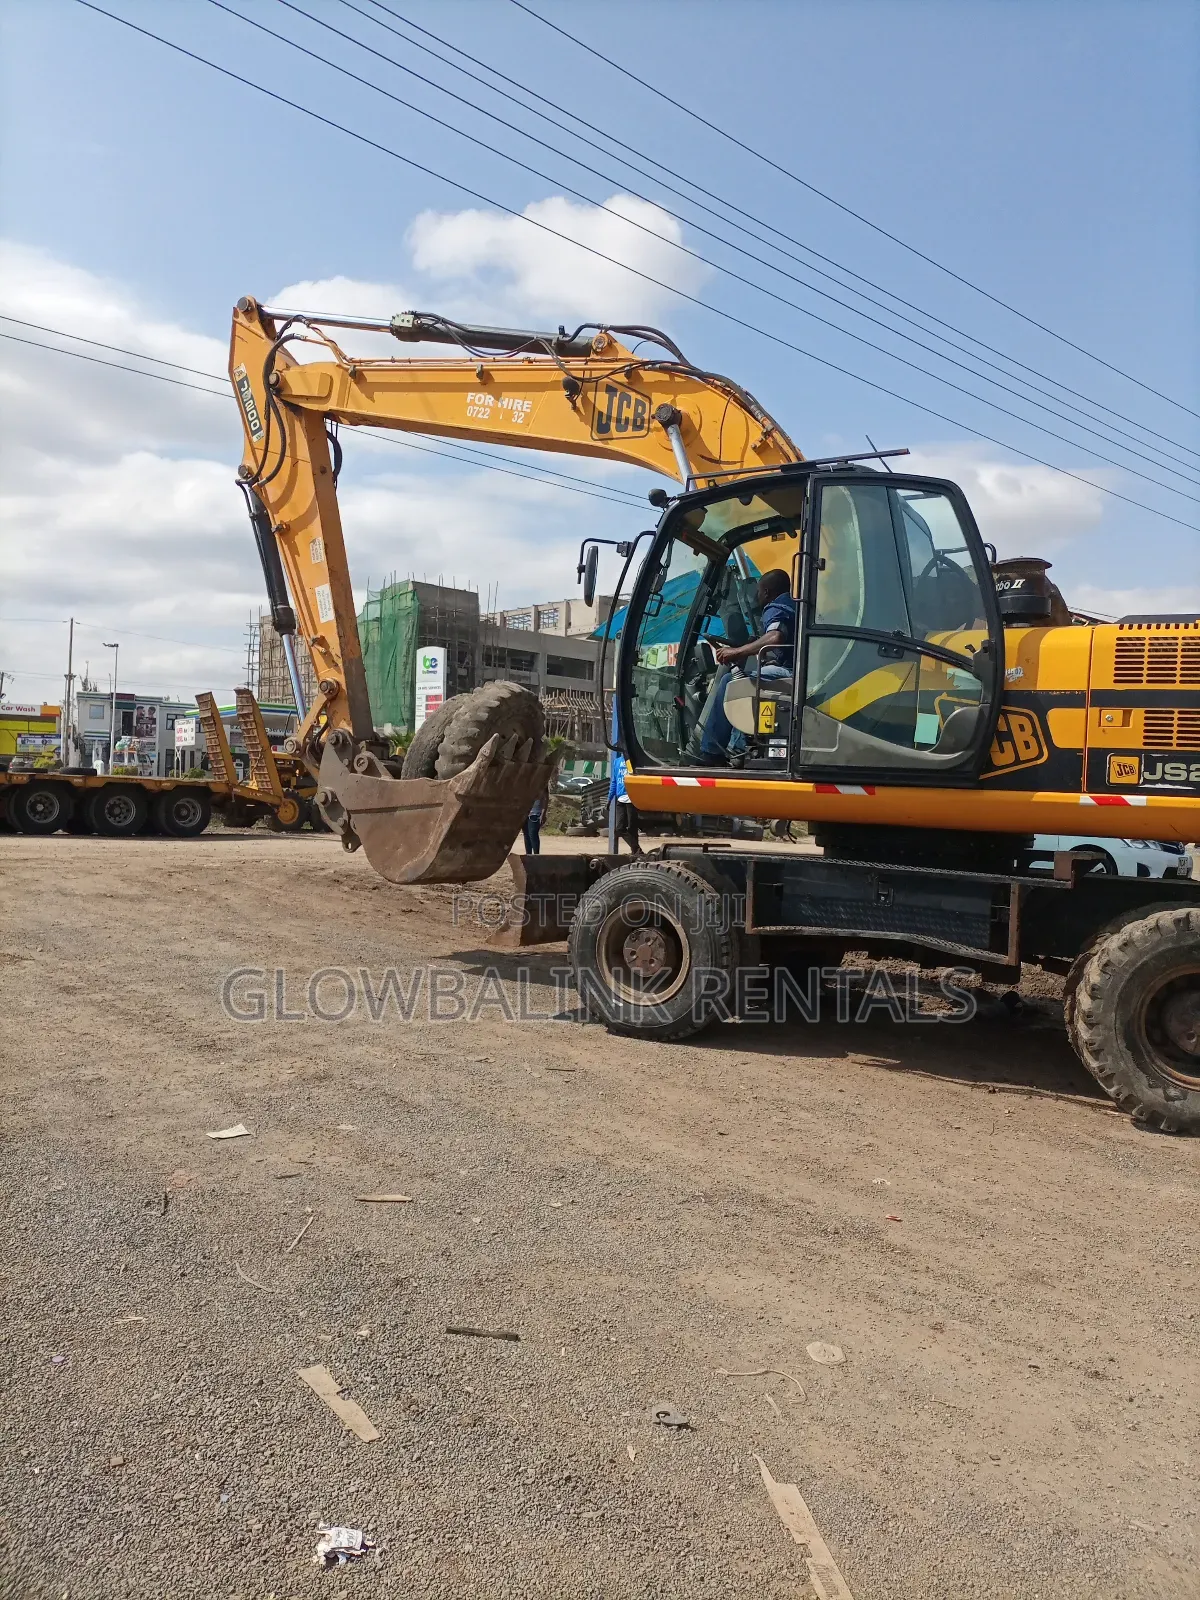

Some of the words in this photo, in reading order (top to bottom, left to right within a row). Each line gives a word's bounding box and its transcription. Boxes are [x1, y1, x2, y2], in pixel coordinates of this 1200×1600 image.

[466, 392, 495, 407] FOR
[498, 396, 533, 412] HIRE
[597, 384, 646, 434] JCB
[466, 405, 490, 419] 0722
[511, 411, 525, 423] 32
[990, 713, 1040, 766] CB
[1116, 763, 1135, 776] JCB
